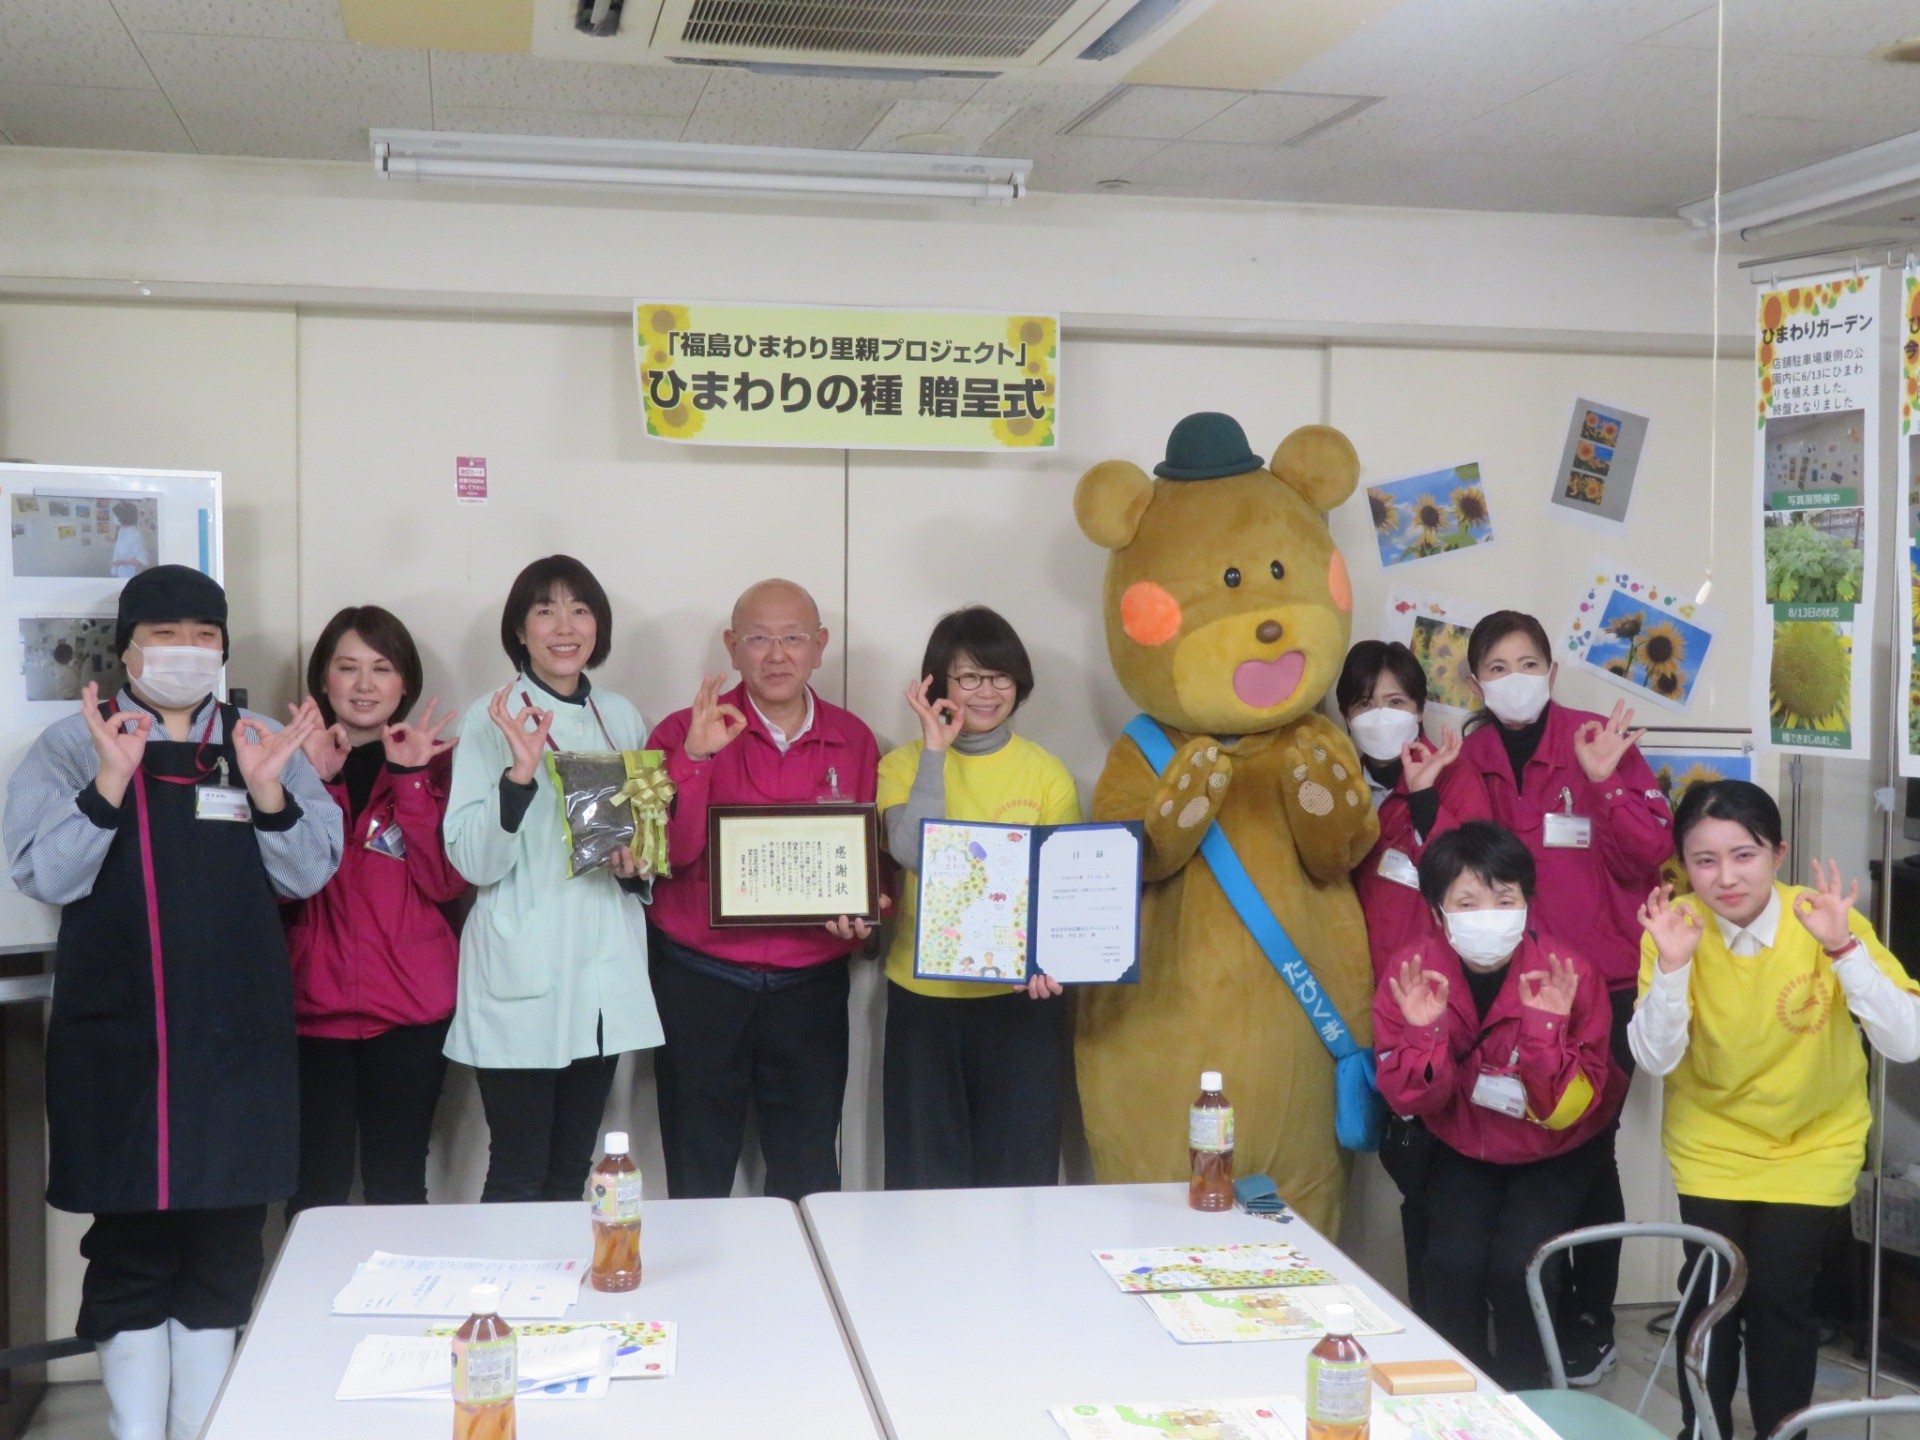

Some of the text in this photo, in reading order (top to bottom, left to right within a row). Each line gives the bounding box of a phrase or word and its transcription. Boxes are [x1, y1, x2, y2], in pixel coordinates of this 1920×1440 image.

[1761, 314, 1873, 345] ひまわりガーデン
[667, 331, 1027, 367] 「福島ひまわり里親プロジェクト」
[1773, 347, 1864, 370] 店舗駐車場東側の公
[1772, 363, 1864, 385] 園内に6/13にひまわ
[648, 369, 1046, 420] ひまわりの種 贈呈式
[1773, 382, 1848, 400] りを植えました。
[1773, 396, 1853, 416] 終盤となりました
[835, 846, 849, 896] 感謝状
[1282, 960, 1345, 1042] たびくま
